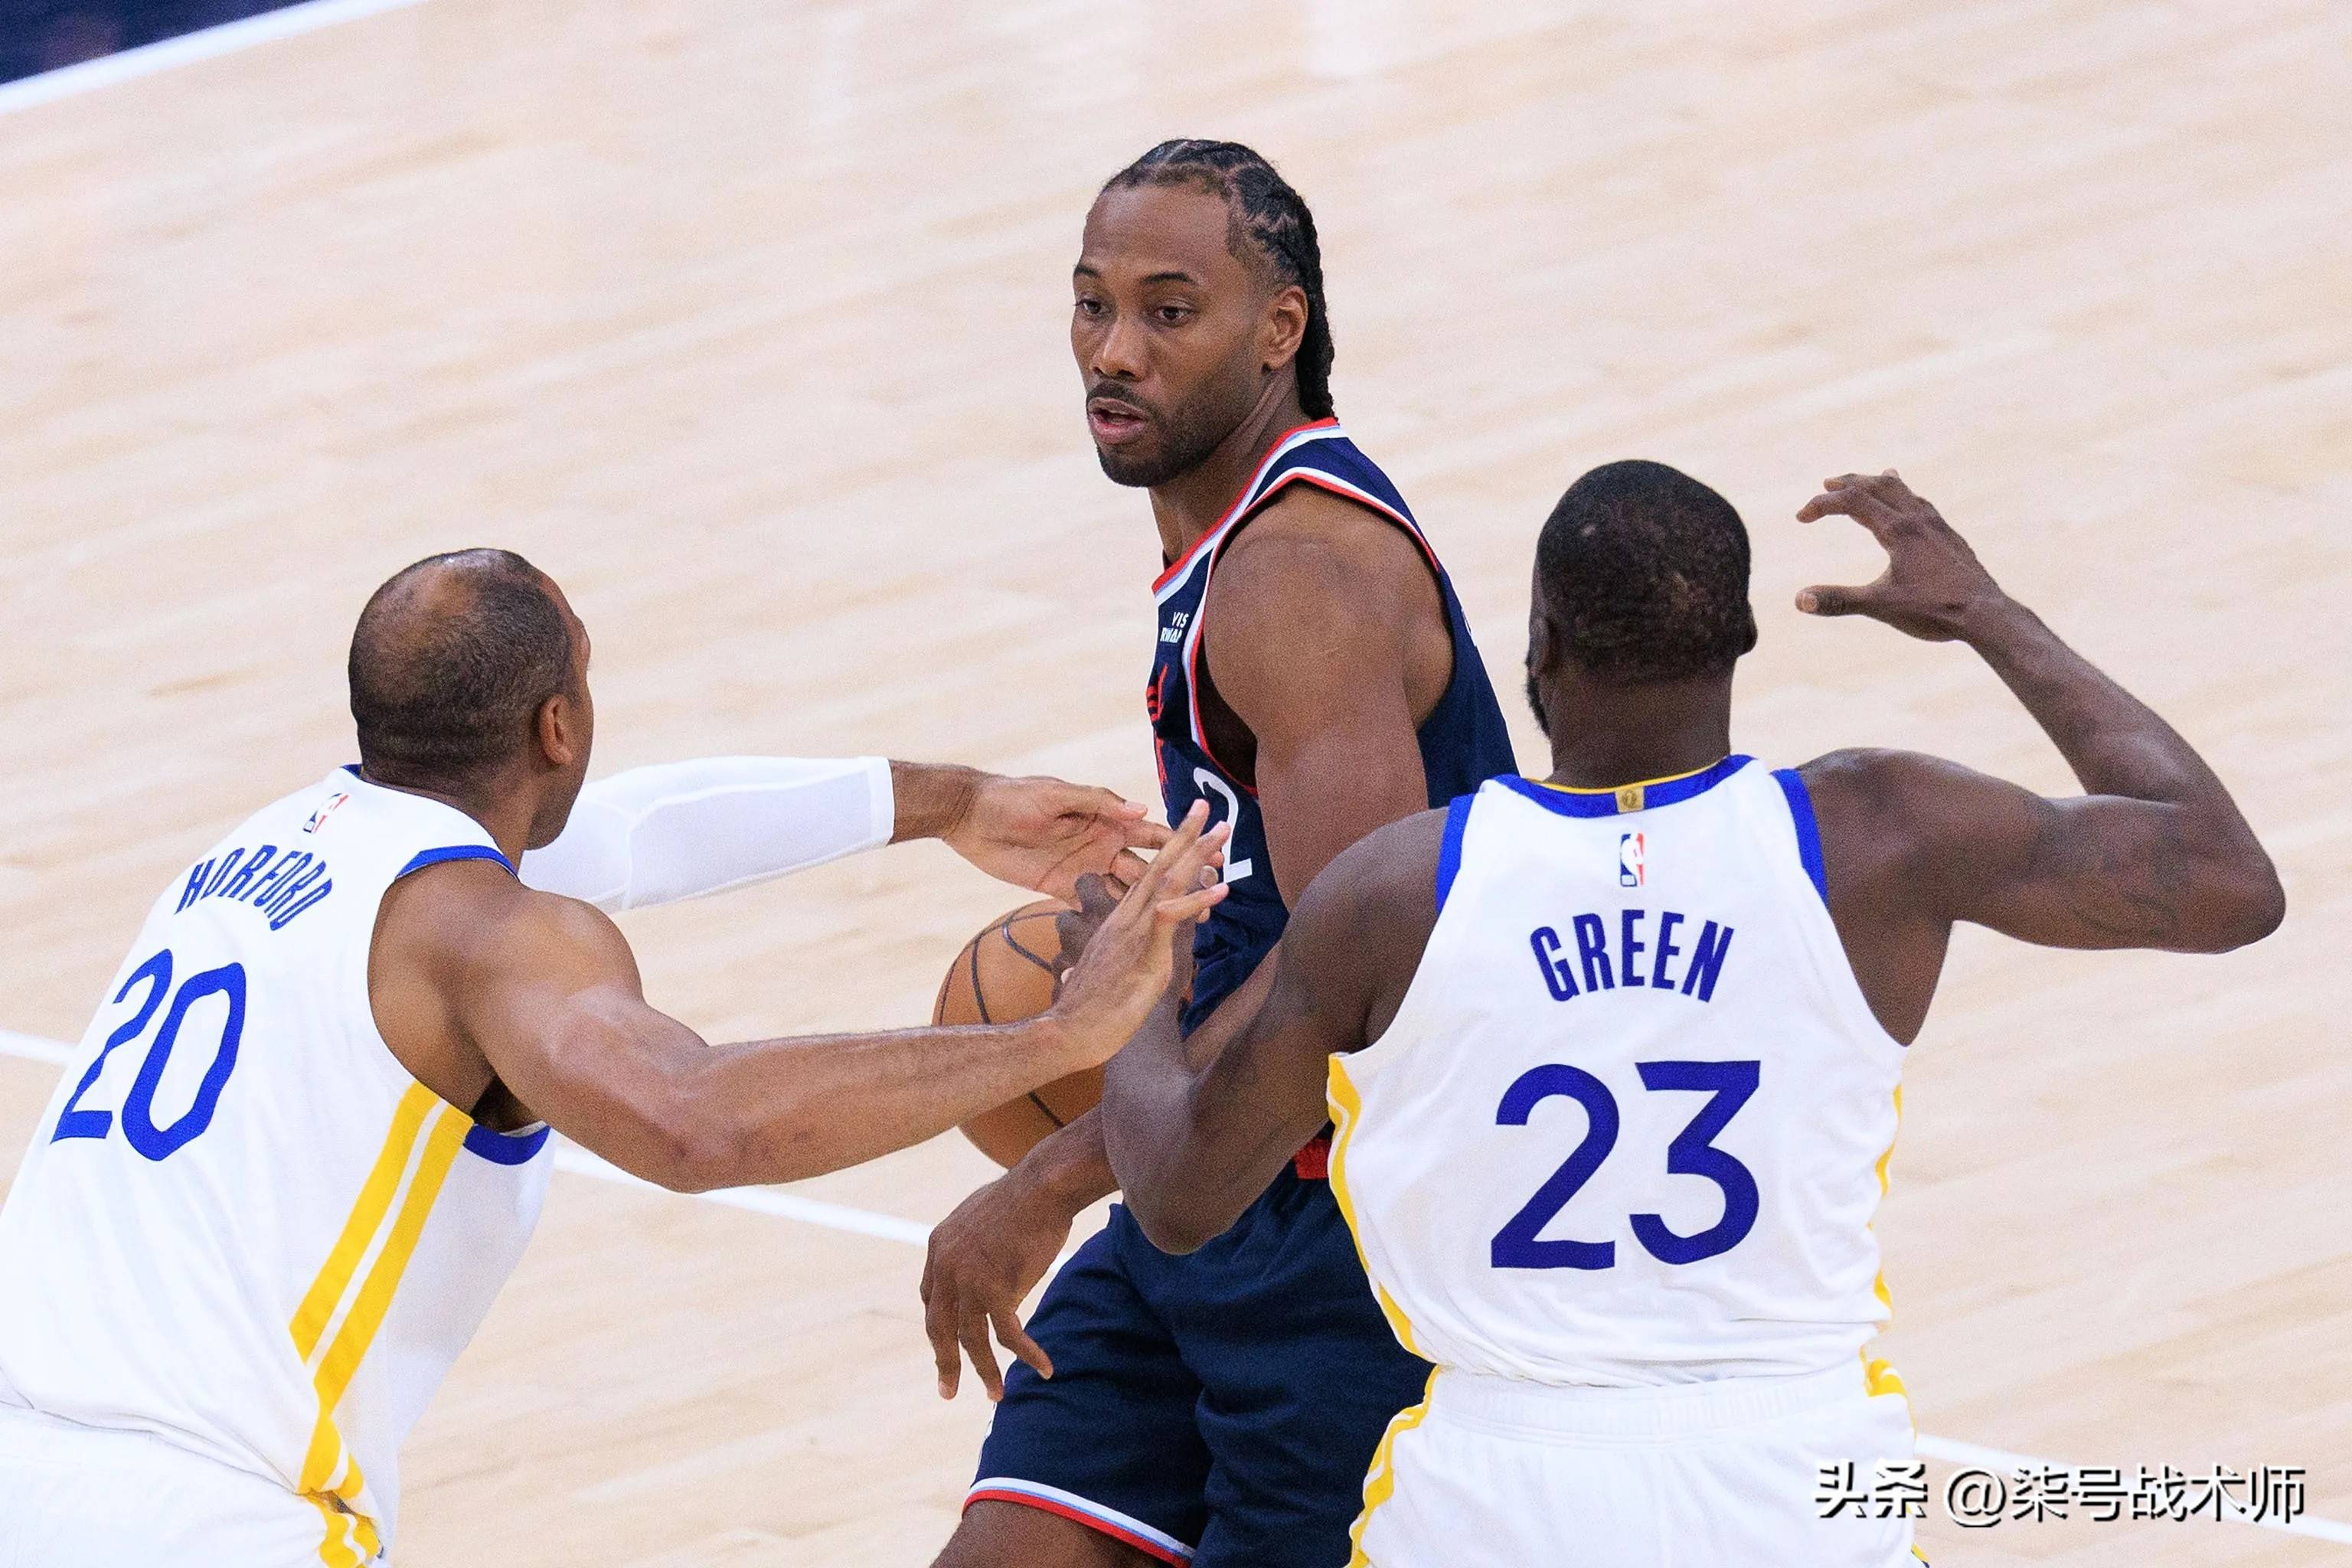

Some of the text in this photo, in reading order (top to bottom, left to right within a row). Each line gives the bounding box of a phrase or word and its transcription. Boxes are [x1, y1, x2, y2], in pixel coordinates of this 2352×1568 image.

[175, 844, 333, 932] HORFORD
[1530, 909, 1735, 1003] GREEN
[50, 948, 247, 1162] 20
[1491, 1060, 1761, 1271] 23
